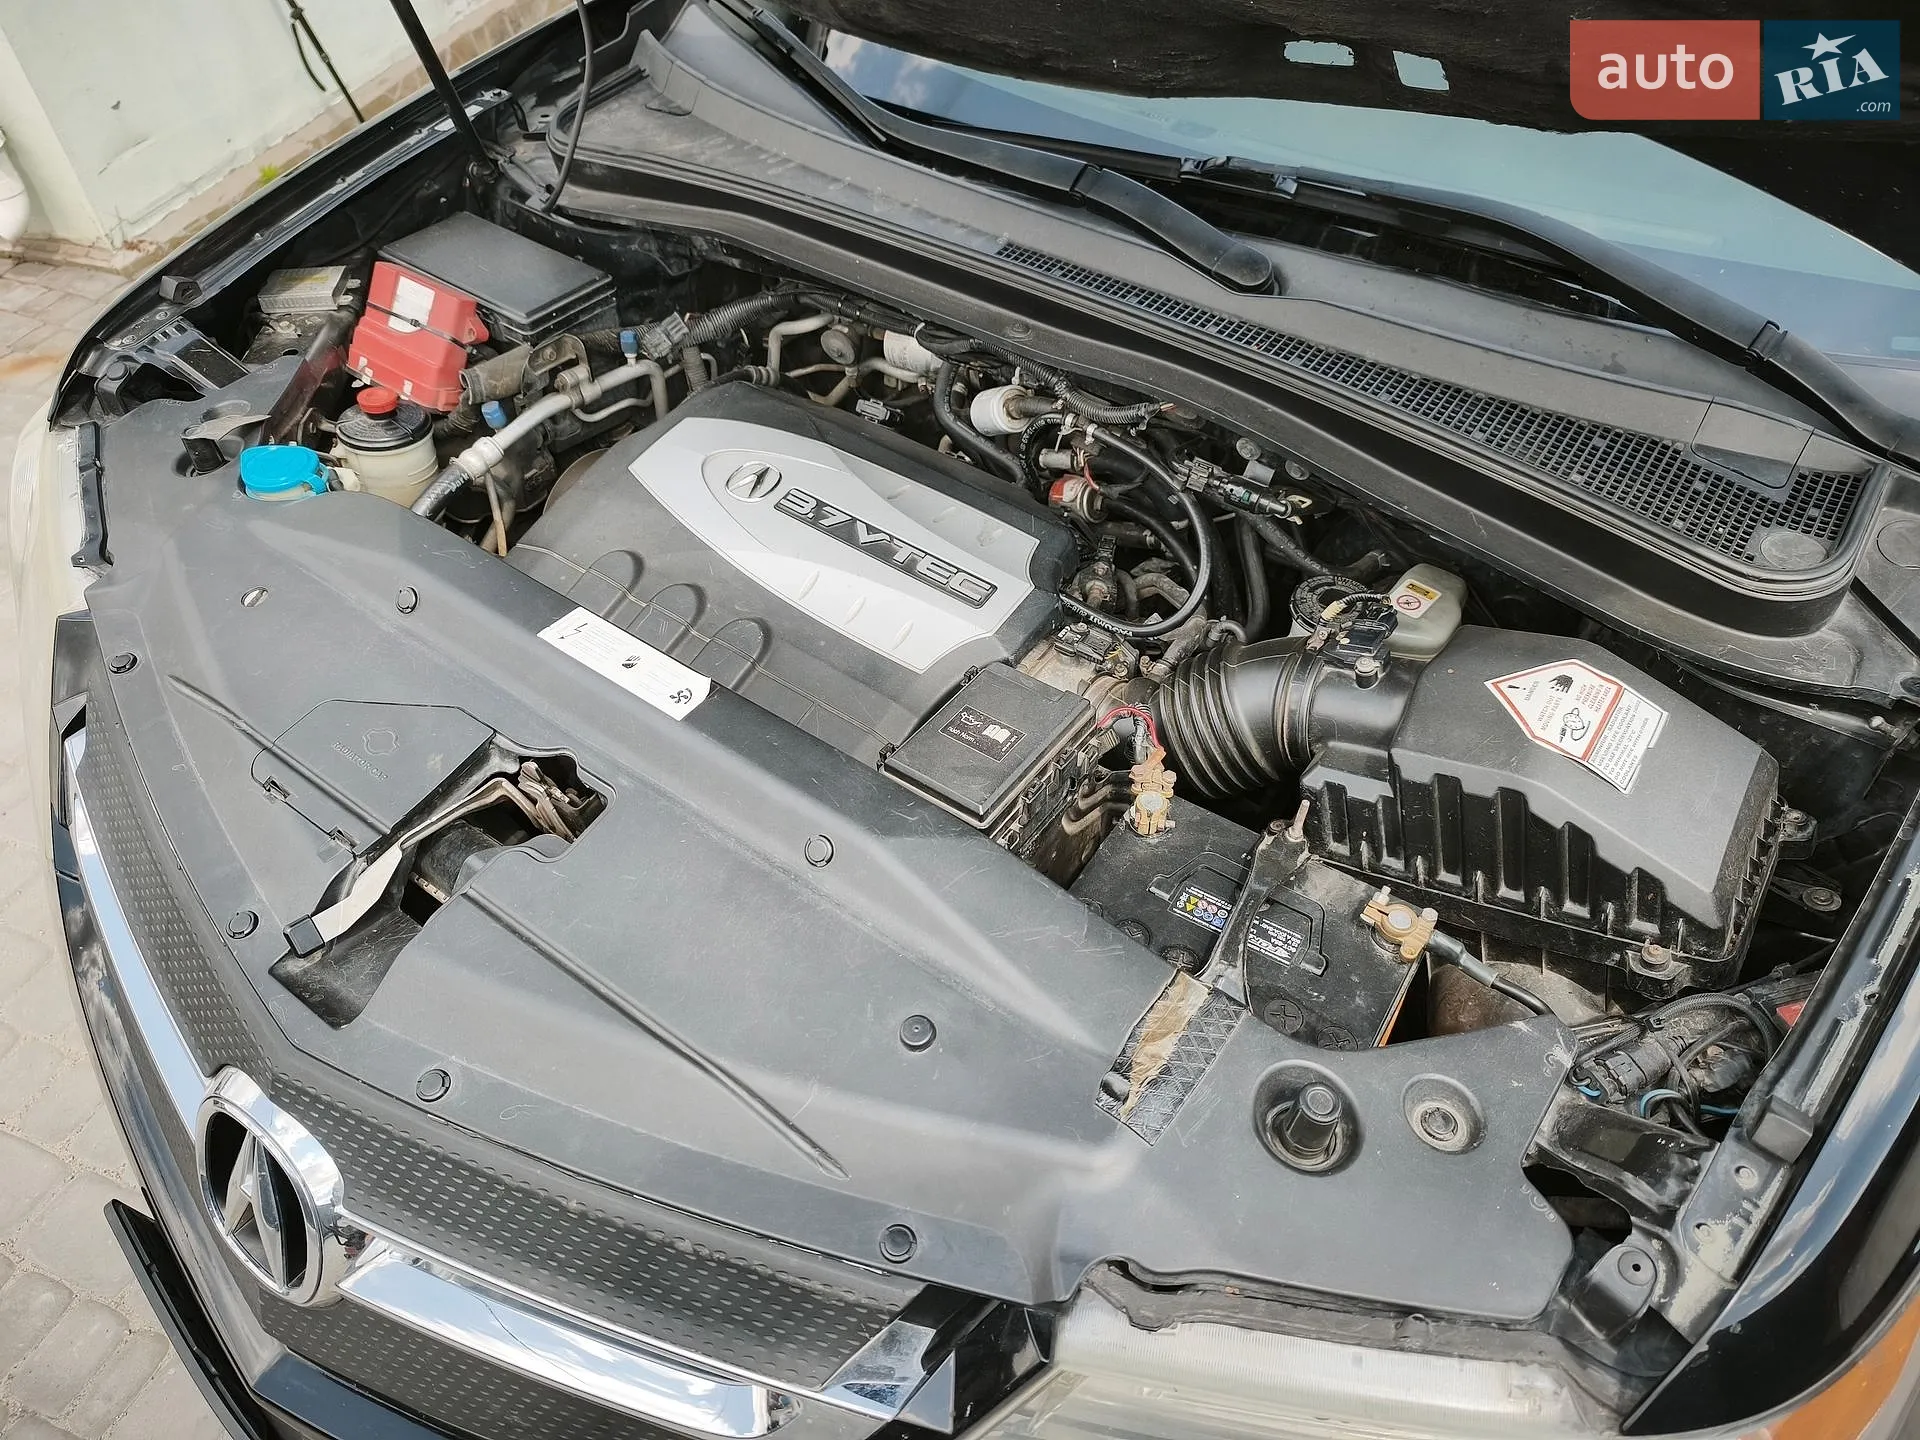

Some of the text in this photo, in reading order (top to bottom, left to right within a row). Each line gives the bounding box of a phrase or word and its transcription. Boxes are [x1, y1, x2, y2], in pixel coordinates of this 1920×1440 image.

[779, 490, 992, 603] 3.7 VTEC
[1540, 711, 1554, 731] MOVING
[332, 740, 372, 770] RADIATOR
[1603, 761, 1610, 770] TO
[1608, 767, 1615, 776] TO
[1613, 770, 1621, 780] DO
